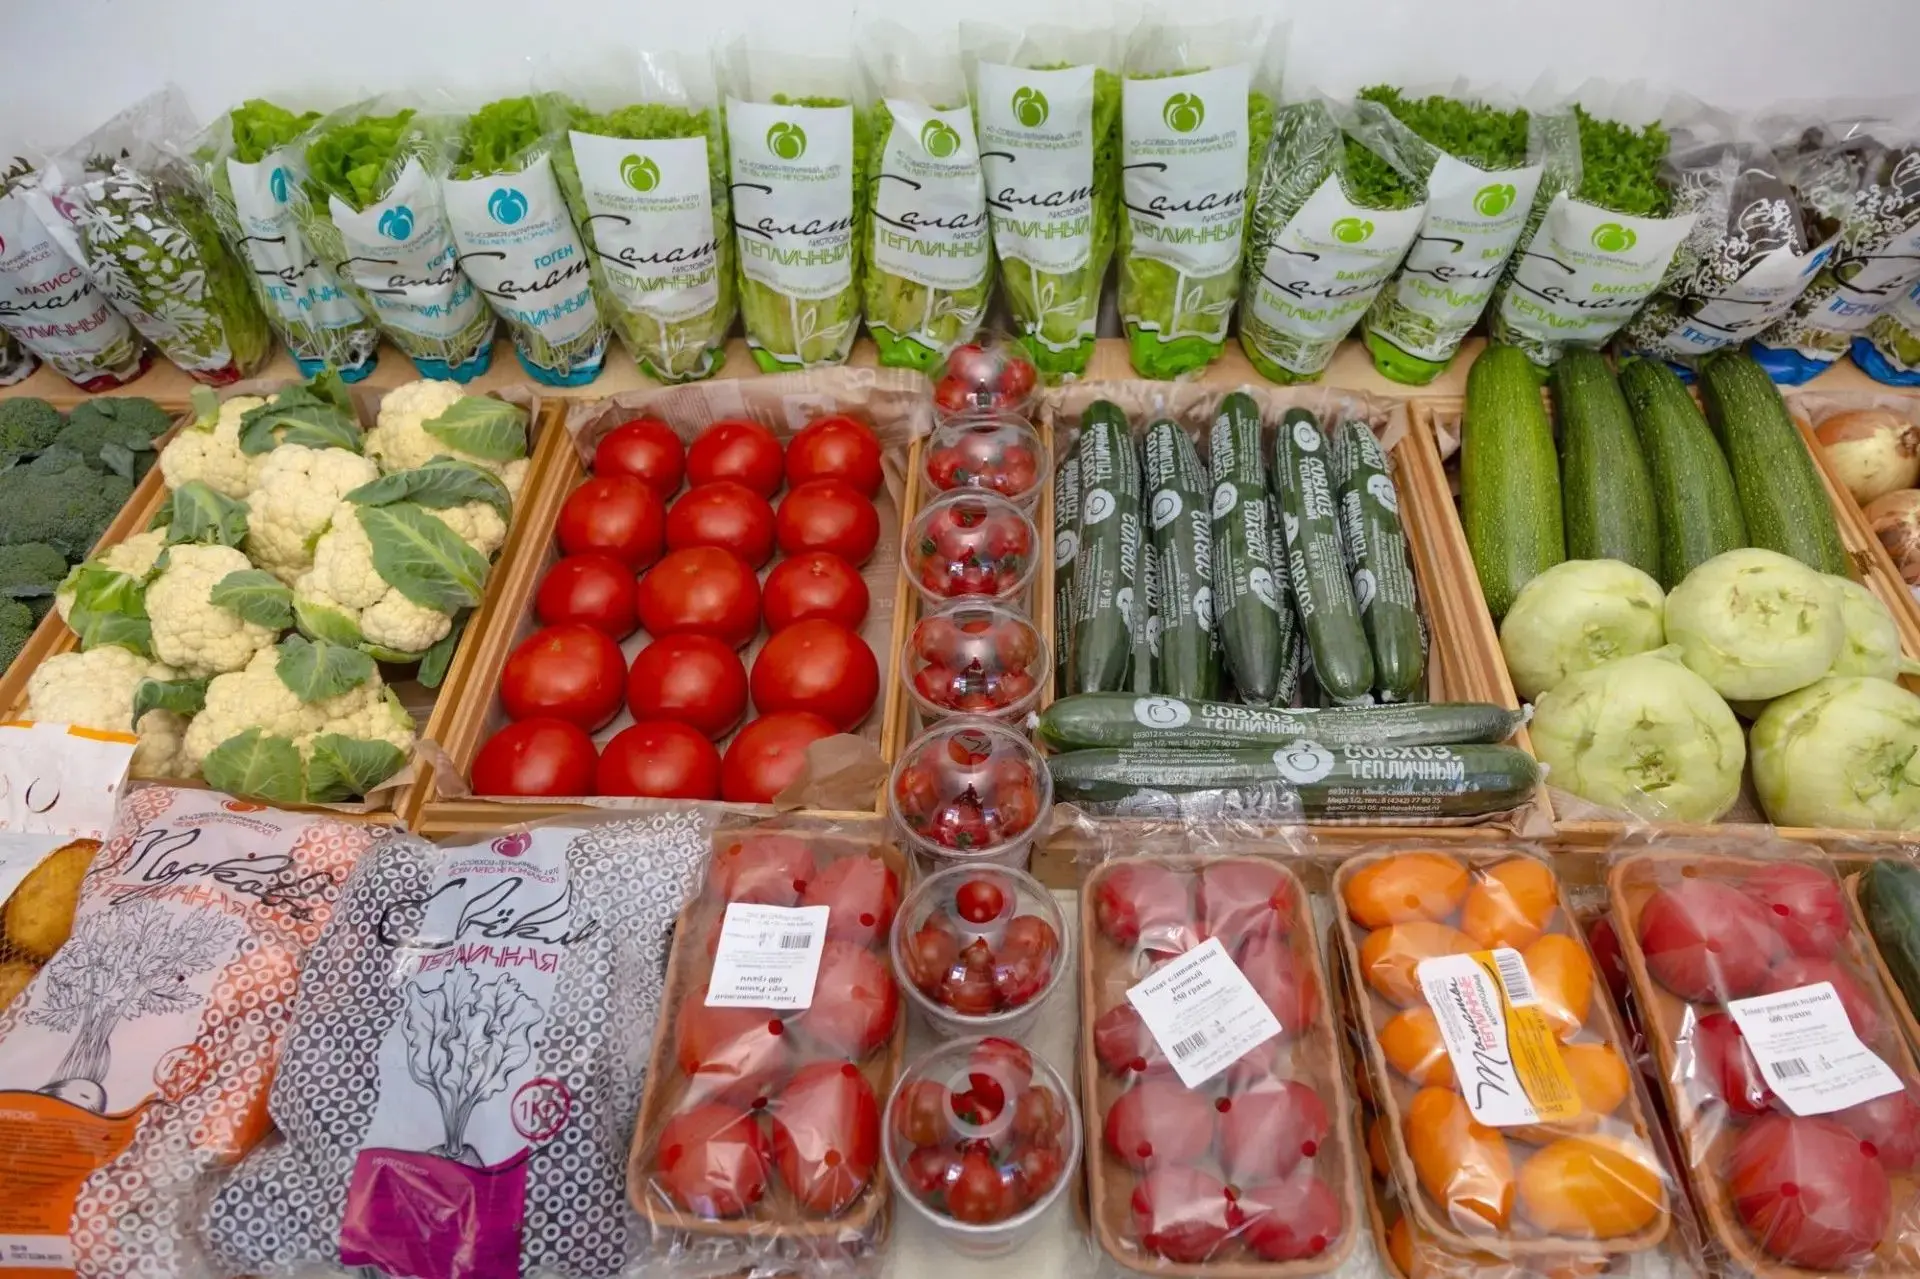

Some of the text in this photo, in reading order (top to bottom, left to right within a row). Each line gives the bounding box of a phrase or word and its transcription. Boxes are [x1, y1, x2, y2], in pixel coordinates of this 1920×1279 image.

[979, 151, 1102, 213] Салат
[1121, 162, 1251, 221] Салат
[730, 182, 862, 241] Салат
[581, 213, 721, 270] Салат
[1130, 216, 1242, 246] ТЕПЛИЧНЫЙ
[534, 244, 574, 270] ГОГЕН
[741, 235, 854, 267] ТЕПЛИЧНЫЙ
[455, 250, 591, 301] Салат
[605, 265, 716, 292] ТЕПЛИЧНЫЙ
[1299, 456, 1320, 520] ТЕПЛИЧНЫЙ
[1309, 456, 1335, 517] СОВХОЗ
[1201, 703, 1296, 724] СОВХОЗ
[1202, 716, 1306, 734] ТЕПЛИЧНЫЙ
[1346, 755, 1466, 781] ТЕПЛИЧНЫЙ
[418, 942, 560, 974] ТЕПЛИЧНАЯ
